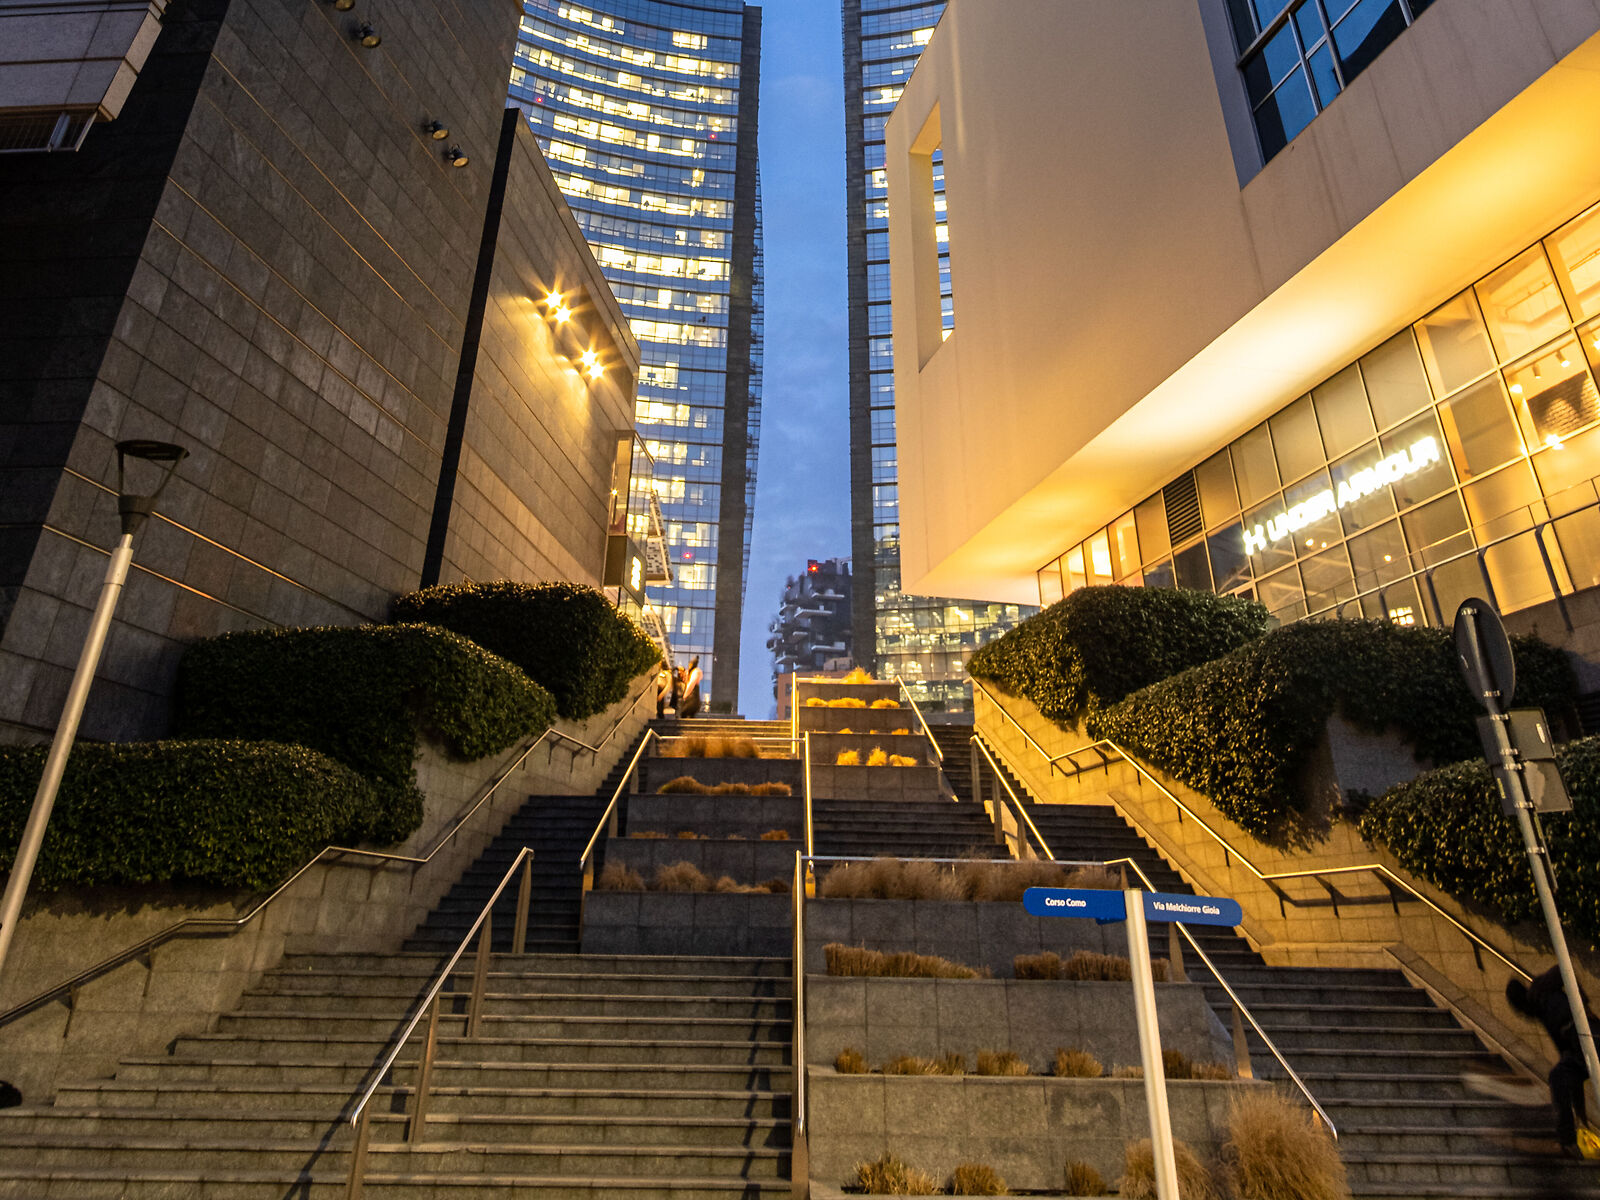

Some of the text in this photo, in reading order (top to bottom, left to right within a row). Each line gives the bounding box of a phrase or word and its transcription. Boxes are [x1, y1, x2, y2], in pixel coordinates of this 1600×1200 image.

[1266, 436, 1440, 542] UNDER ARMOUR
[1045, 898, 1086, 907] Corso Como
[1153, 901, 1220, 915] Via Melchiorre Gioia
